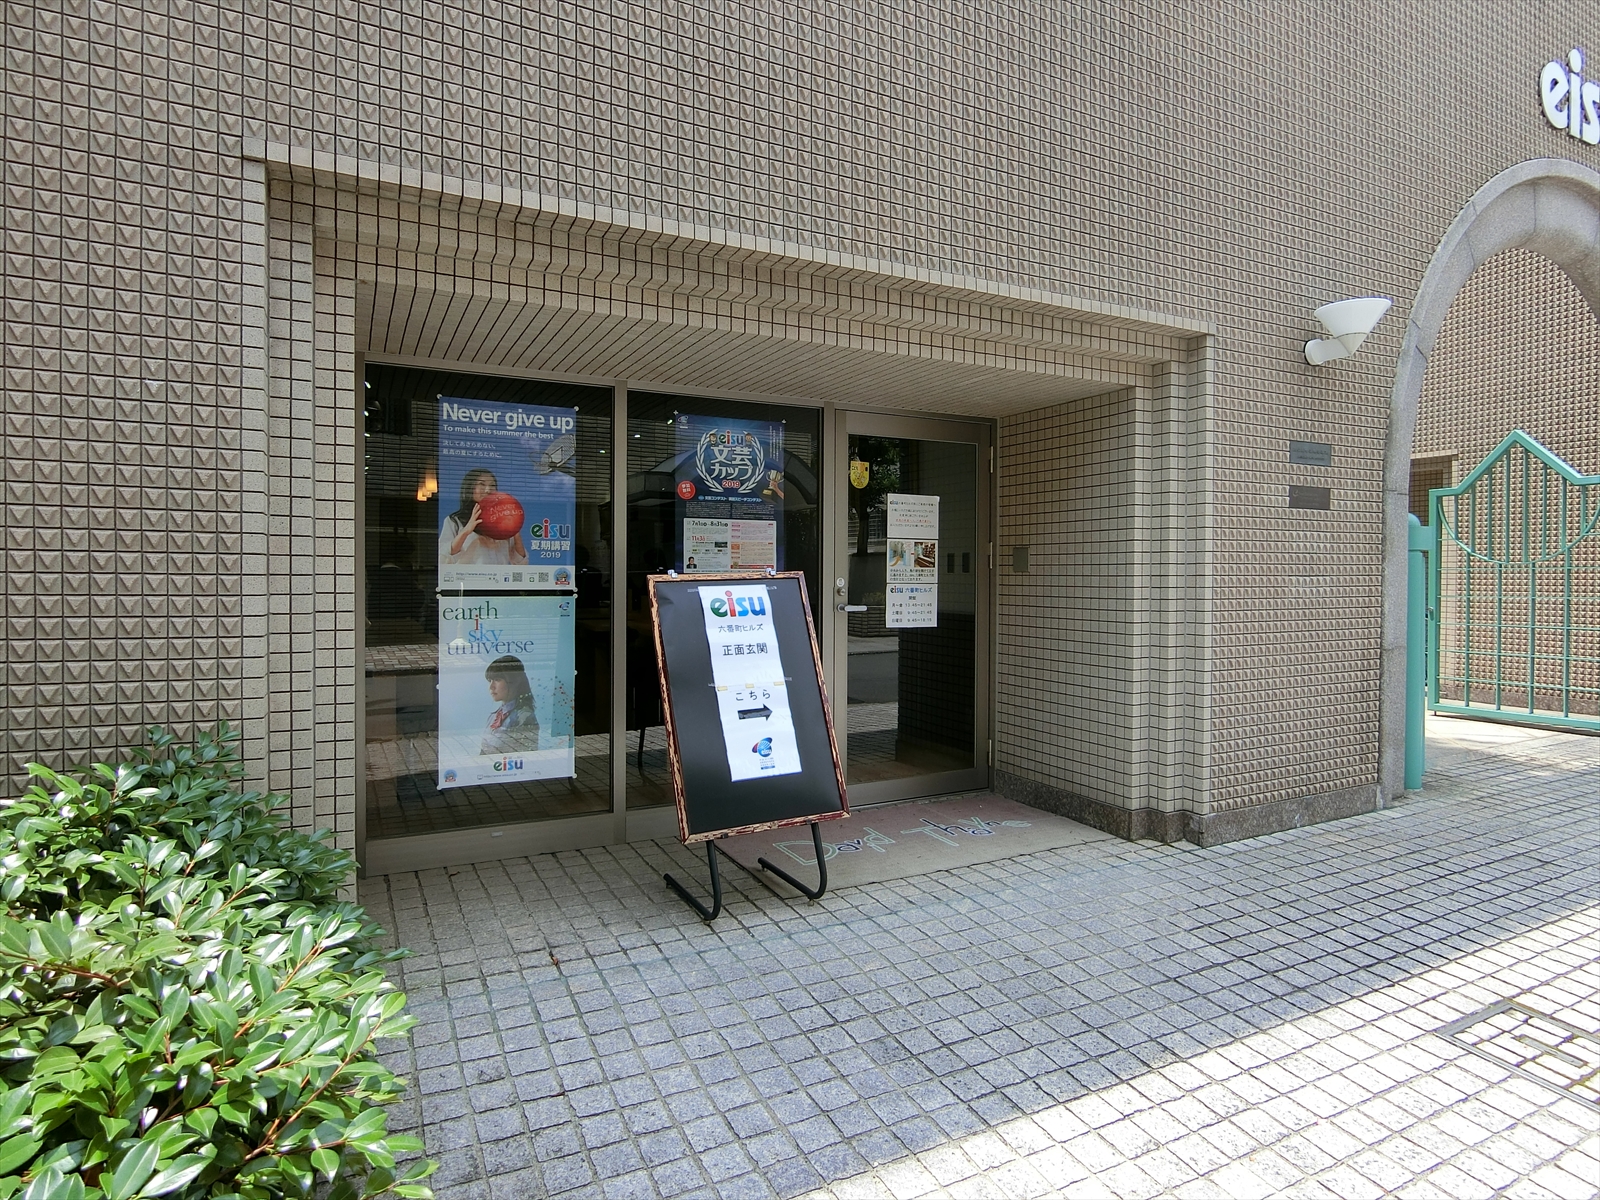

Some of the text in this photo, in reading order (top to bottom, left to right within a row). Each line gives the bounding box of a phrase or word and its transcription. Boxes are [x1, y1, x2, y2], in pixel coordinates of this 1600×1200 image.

[442, 402, 574, 433] Never give up
[443, 424, 453, 432] To
[455, 426, 476, 434] make
[478, 426, 492, 435] this
[493, 429, 521, 437] summer
[718, 430, 745, 446] eisu
[710, 445, 753, 465] 文芸
[710, 464, 754, 480] カップ
[721, 480, 741, 489] 2019
[530, 518, 571, 539] eisu
[530, 541, 571, 551] 夏期講習
[890, 585, 903, 594] eisu
[442, 601, 500, 621] earth
[710, 590, 766, 617] eisu
[468, 623, 503, 647] sky
[718, 623, 764, 633] 六番町ヒルズ
[446, 638, 534, 655] universe
[722, 642, 768, 656] 正面玄関
[735, 689, 771, 701] こちら
[493, 756, 524, 771] eisu
